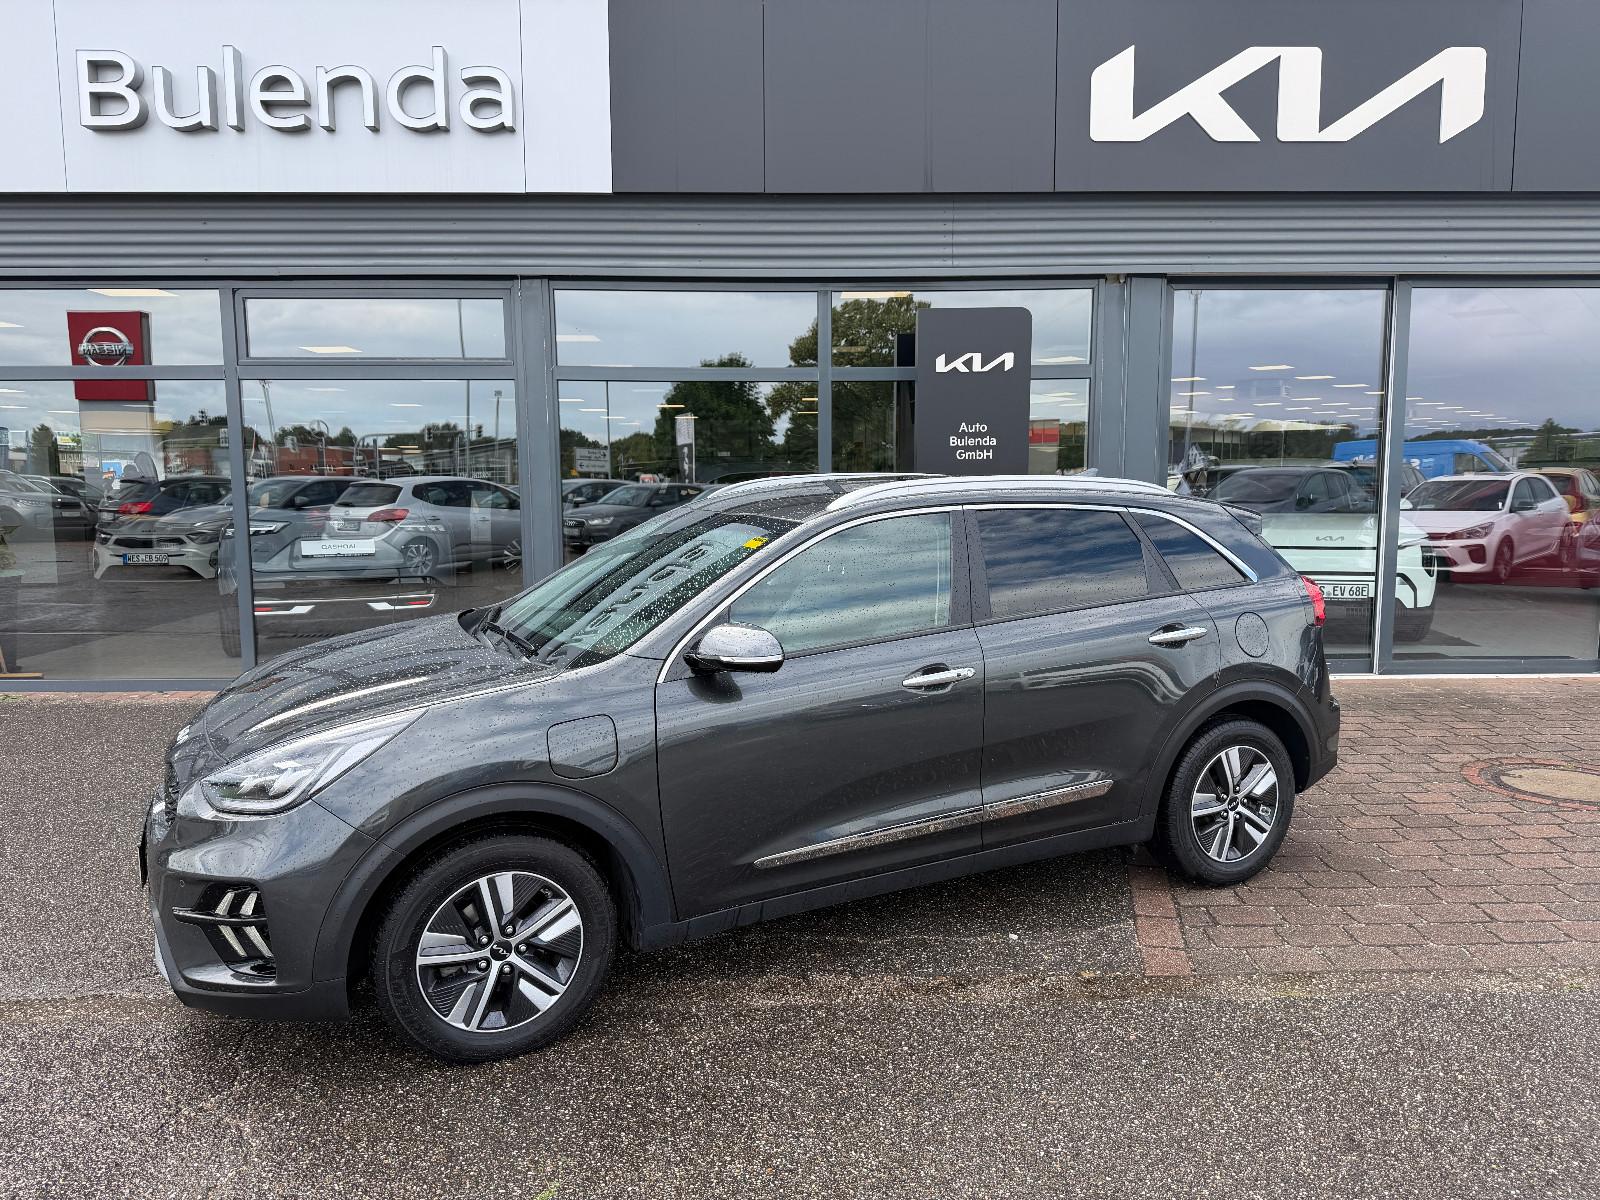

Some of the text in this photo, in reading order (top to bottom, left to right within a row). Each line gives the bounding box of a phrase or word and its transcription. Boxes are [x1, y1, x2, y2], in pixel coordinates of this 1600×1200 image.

[75, 45, 517, 133] Bulenda
[1089, 44, 1488, 144] KIA
[935, 351, 1015, 373] KIA
[958, 422, 988, 433] Auto
[949, 435, 997, 447] Bulenda
[956, 449, 993, 460] GmbH
[1332, 585, 1346, 597] EV
[1348, 585, 1368, 597] 68E
